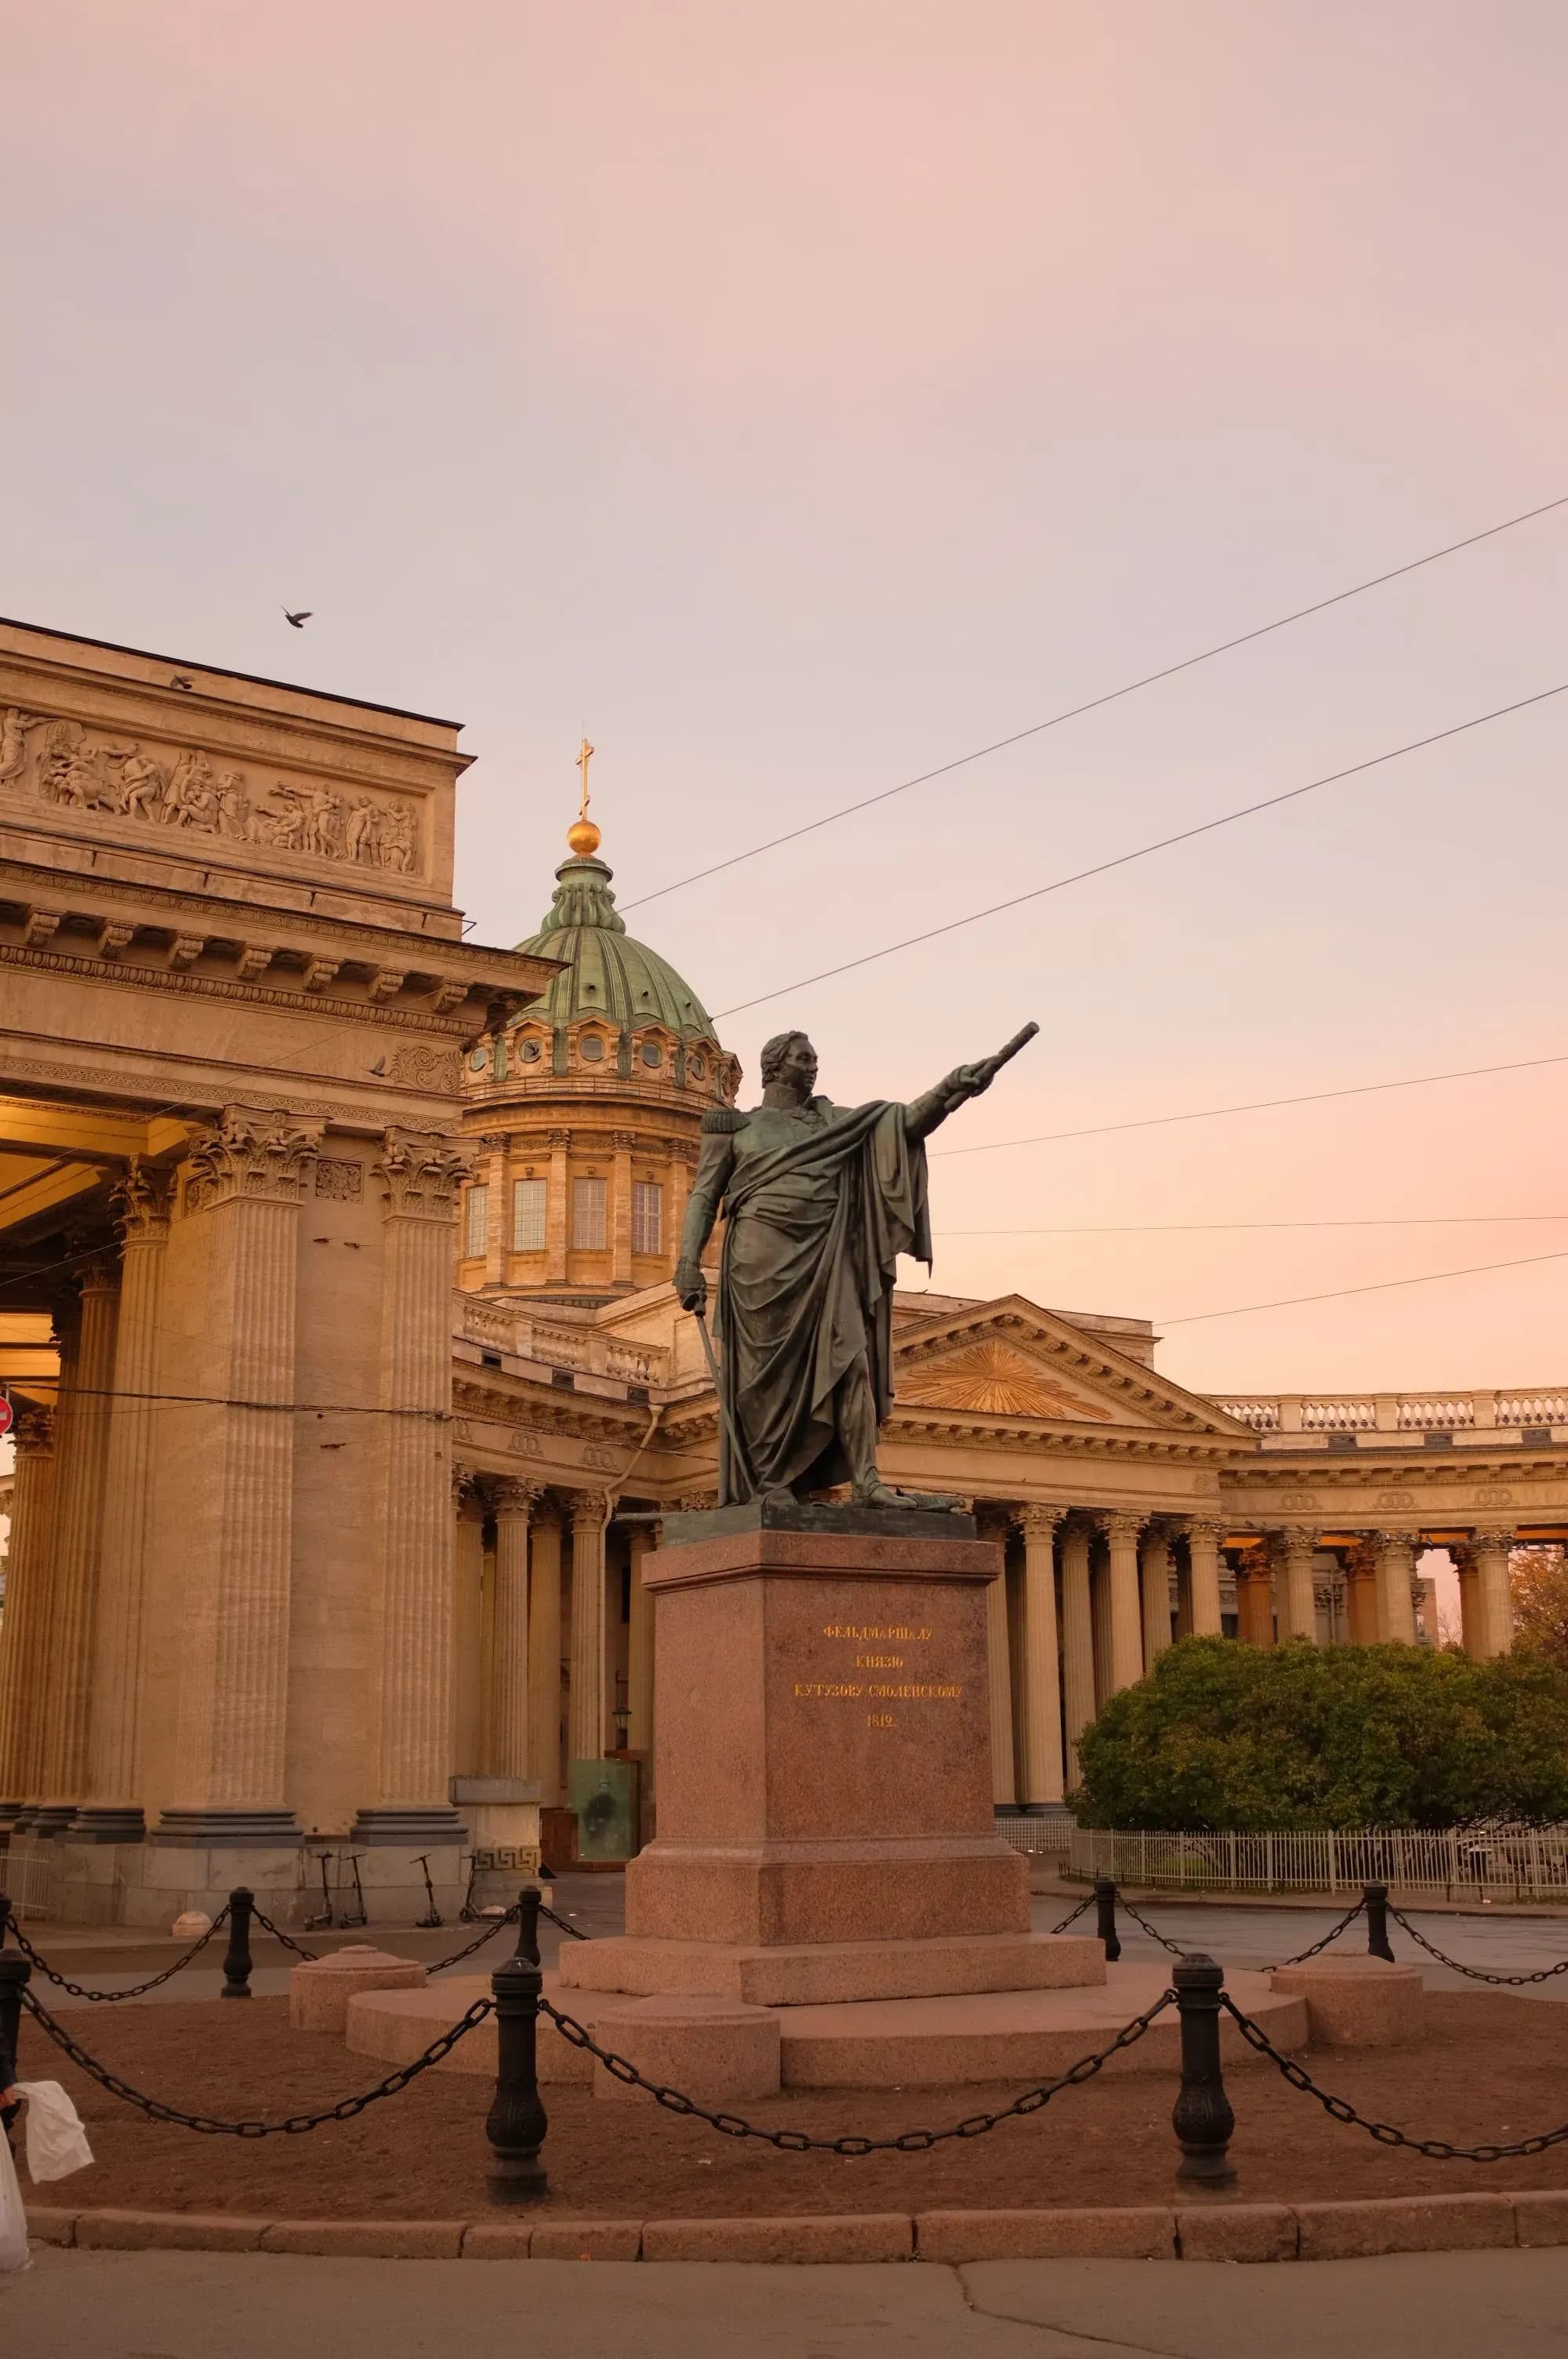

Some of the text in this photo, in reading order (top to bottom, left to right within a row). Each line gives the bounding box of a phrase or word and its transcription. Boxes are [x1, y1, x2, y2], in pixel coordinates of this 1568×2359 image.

[823, 1625, 933, 1641] ФЕЛЬДМАРШАЛУ
[856, 1656, 903, 1668] КНЯЗЮ
[794, 1684, 963, 1698] КУТУЗОВУ СМОЛЕНСКОМУ
